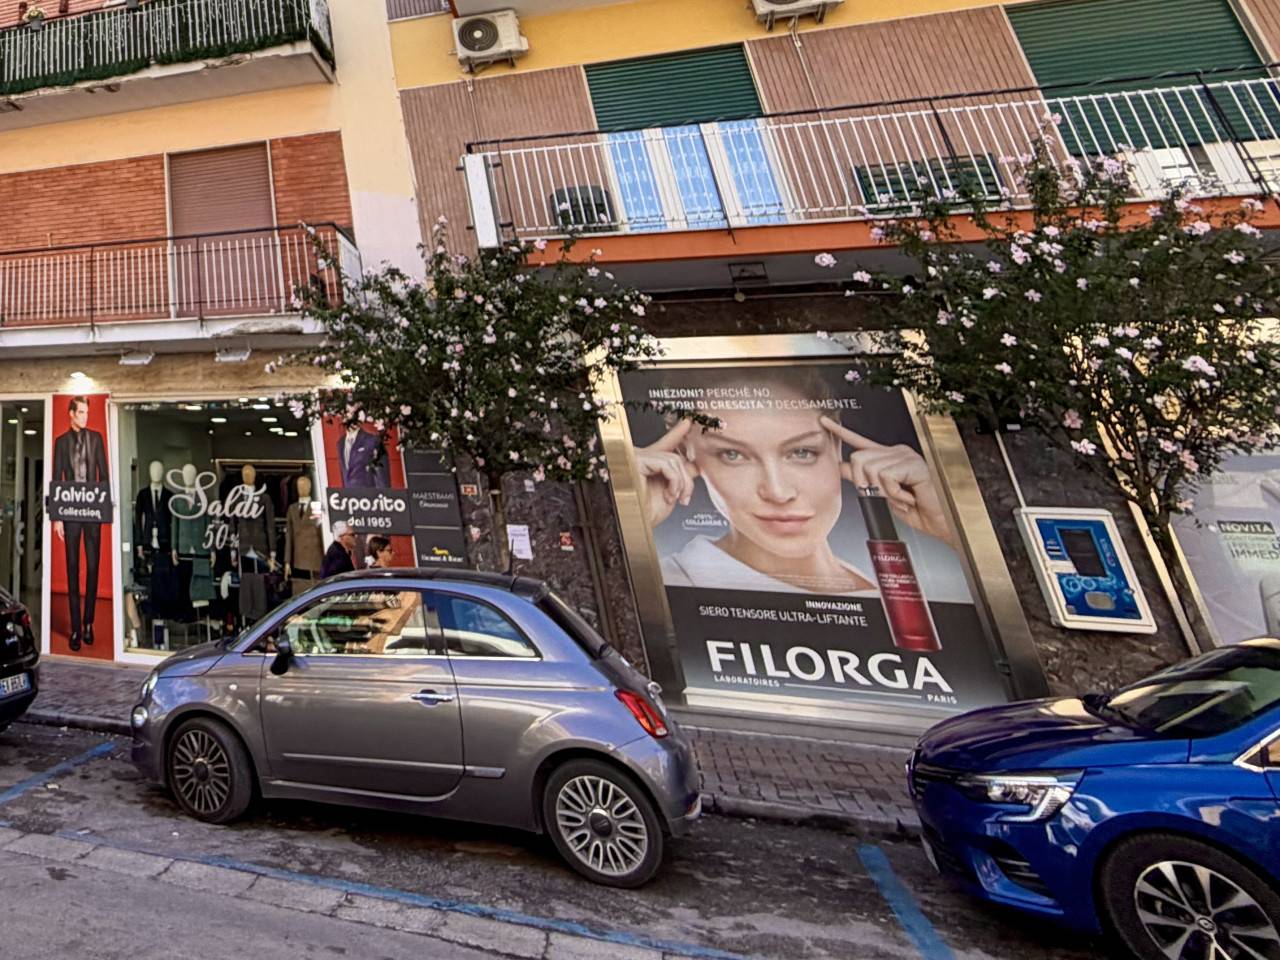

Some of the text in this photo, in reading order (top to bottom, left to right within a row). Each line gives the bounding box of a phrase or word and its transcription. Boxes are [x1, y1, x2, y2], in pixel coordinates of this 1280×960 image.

[648, 388, 704, 399] INIEZIONI?
[697, 400, 709, 410] DI
[53, 486, 107, 503] Salvio's
[166, 468, 267, 520] Saldi
[329, 492, 406, 515] Esposito
[58, 506, 102, 520] Collection
[347, 515, 393, 529] dal 1965
[805, 600, 863, 612] INNOVAZIONE
[698, 605, 868, 628] SIERO TENSORE ULTRA-LIFTANTE
[705, 639, 954, 693] FILORGA
[714, 674, 781, 688] LABORATOIRES
[926, 693, 958, 705] PARIS
